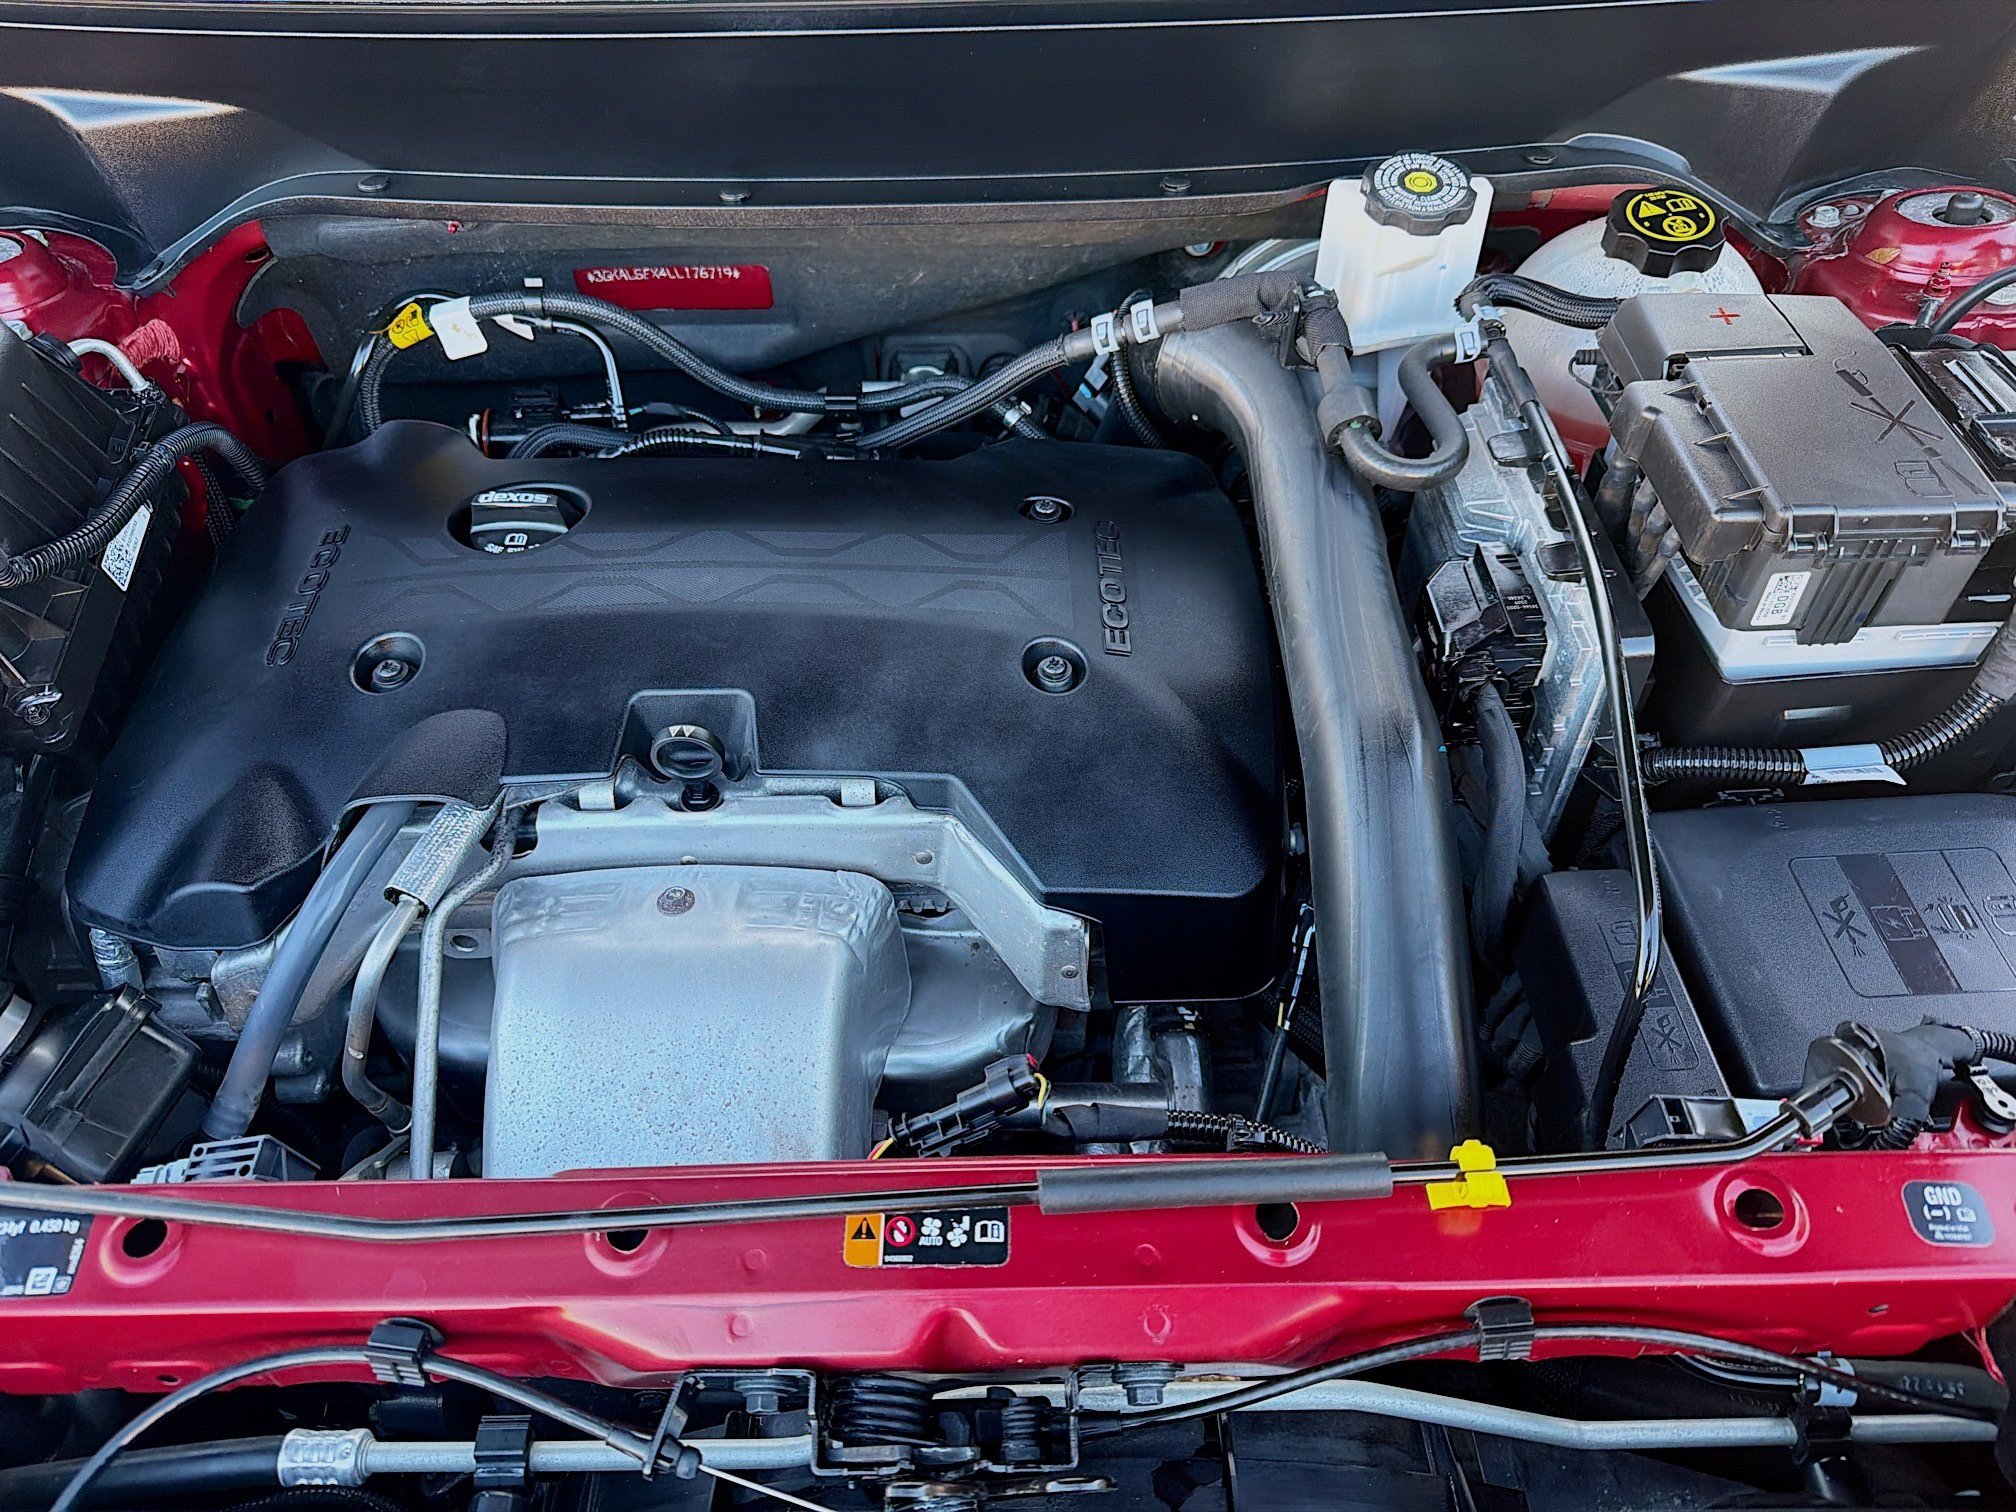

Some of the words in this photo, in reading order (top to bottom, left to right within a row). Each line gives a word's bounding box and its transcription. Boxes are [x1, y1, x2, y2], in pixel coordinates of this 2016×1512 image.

[478, 491, 549, 503] dexos
[266, 524, 351, 667] ECOTEC
[1094, 520, 1132, 657] ECOTEC
[1924, 1186, 1963, 1206] GND
[918, 1236, 943, 1247] AUTO
